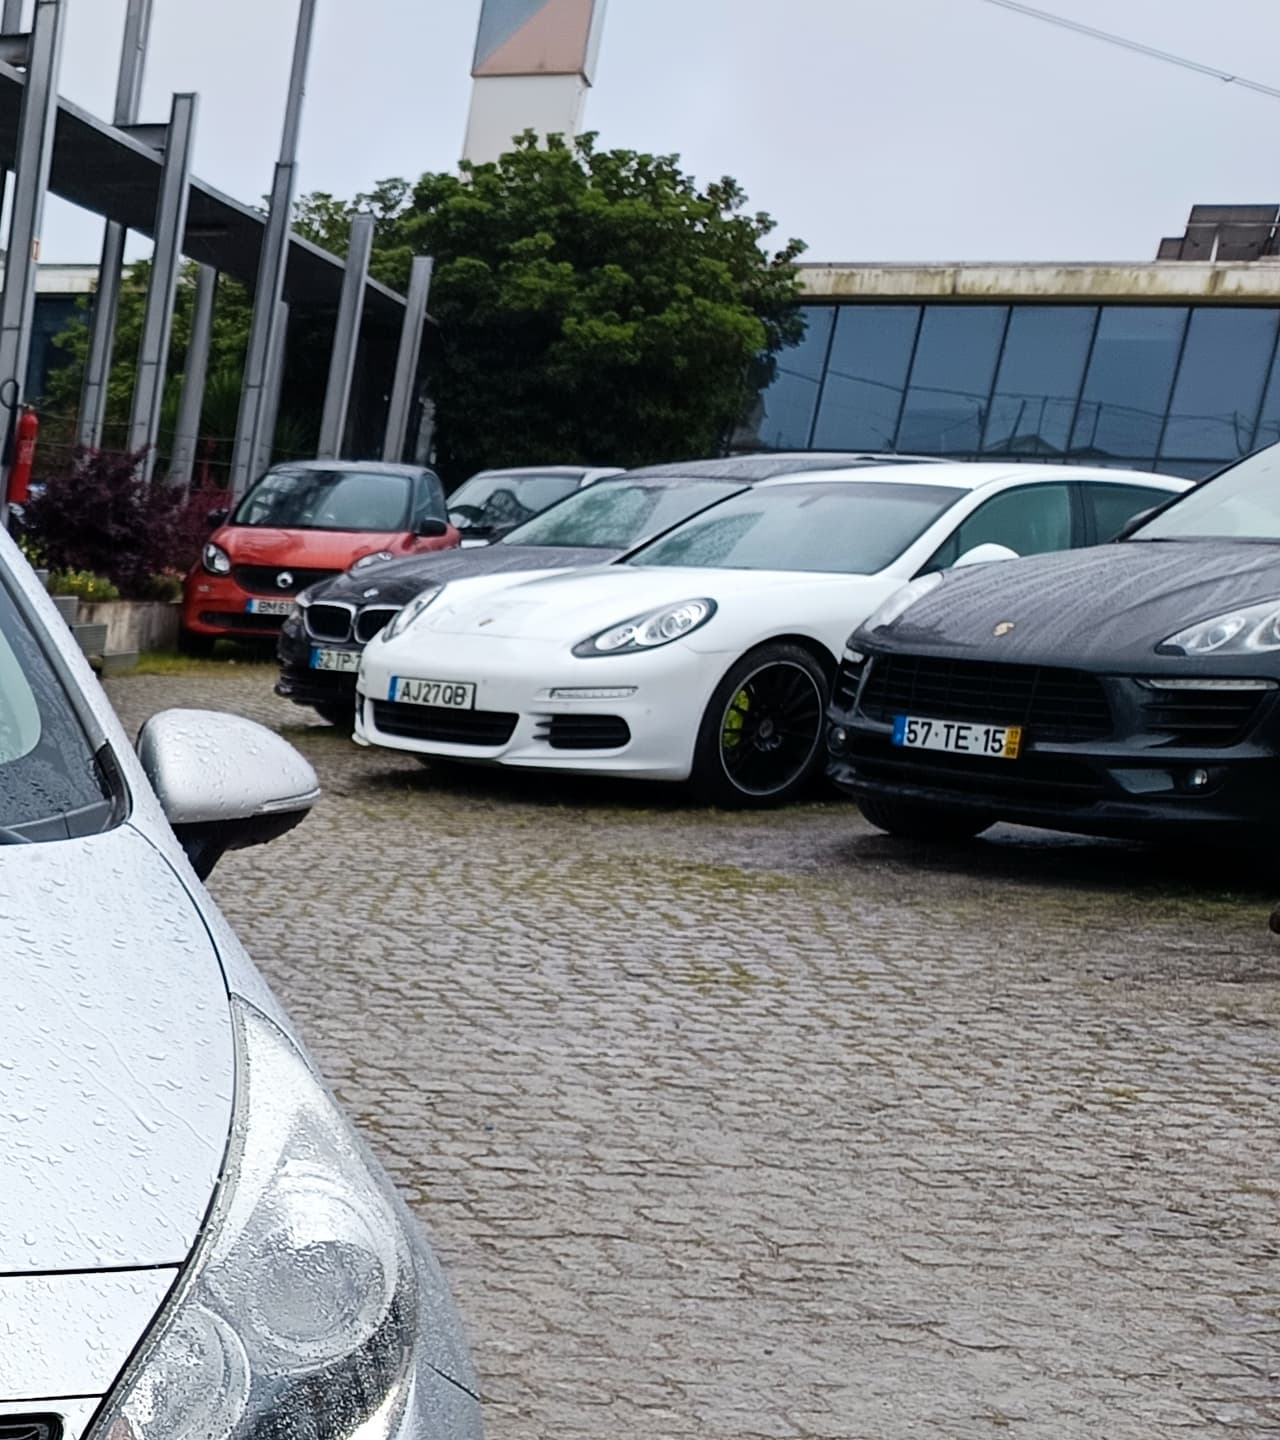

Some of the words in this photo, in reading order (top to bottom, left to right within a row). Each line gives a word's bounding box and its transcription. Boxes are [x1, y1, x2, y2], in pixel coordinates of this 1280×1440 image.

[906, 720, 933, 746] 57
[943, 724, 973, 751] TE
[983, 728, 1007, 753] 15
